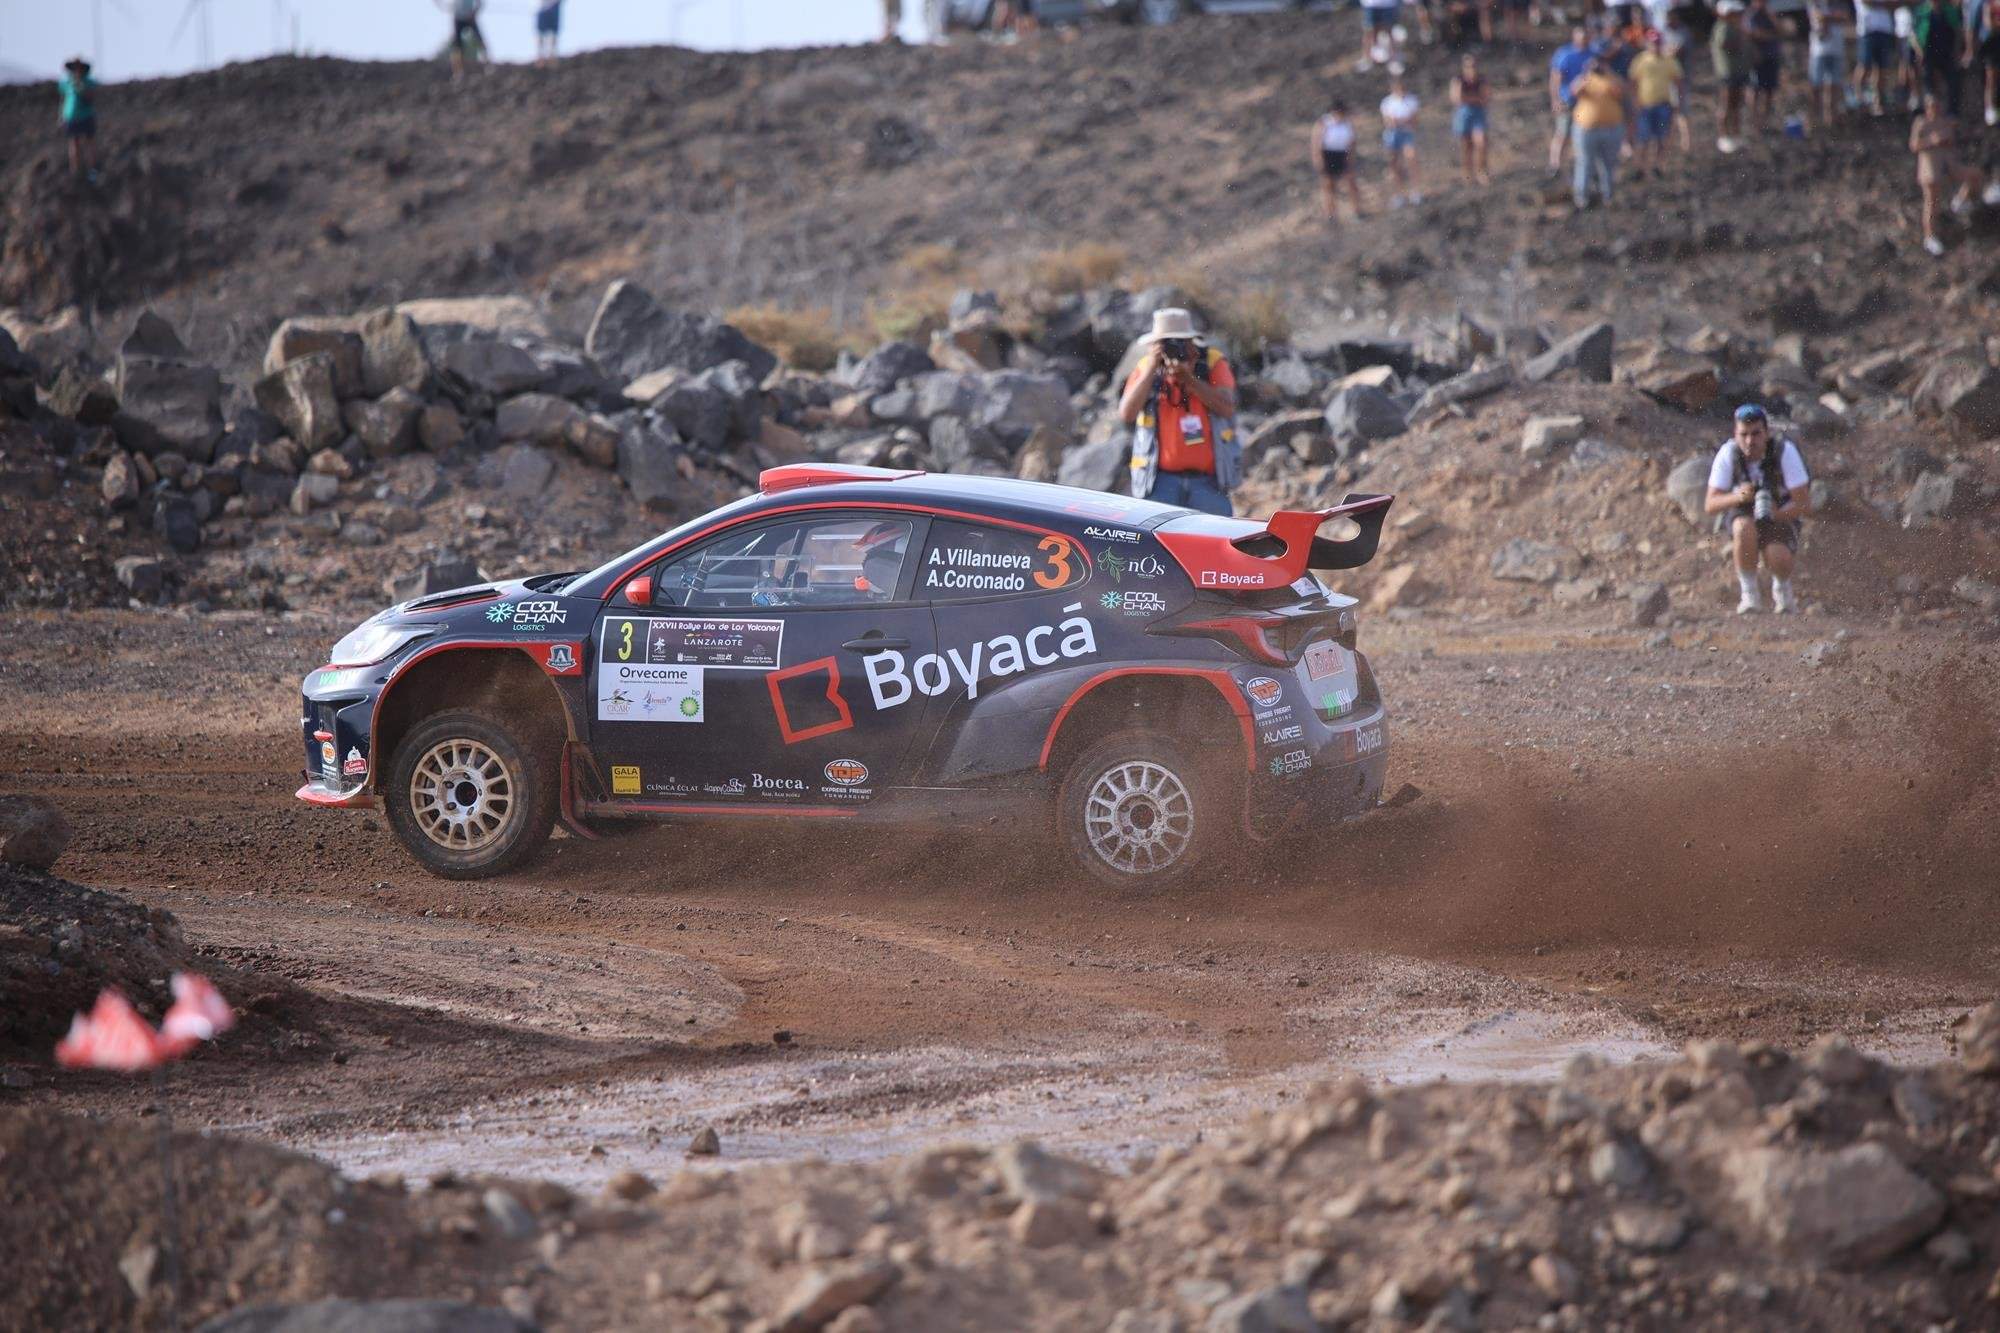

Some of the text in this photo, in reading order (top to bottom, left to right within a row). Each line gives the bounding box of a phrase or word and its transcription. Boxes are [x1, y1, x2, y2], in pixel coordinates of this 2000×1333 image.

[928, 548, 1031, 569] A.Villanueva
[1033, 536, 1071, 589] 3
[926, 570, 1025, 590] A.Coronado
[1124, 592, 1166, 603] COOL
[516, 600, 567, 613] COOL
[1124, 602, 1166, 611] CHAIN
[513, 613, 566, 624] CHAIN
[652, 621, 677, 630] XXVII
[678, 622, 701, 631] Rallye
[718, 623, 729, 631] de
[618, 621, 633, 661] 3
[684, 638, 743, 646] LANZAROTE
[620, 667, 688, 679] Orvecame
[1284, 749, 1311, 764] COOL
[1285, 759, 1312, 773] CHAIN
[752, 773, 810, 790] Bocca.
